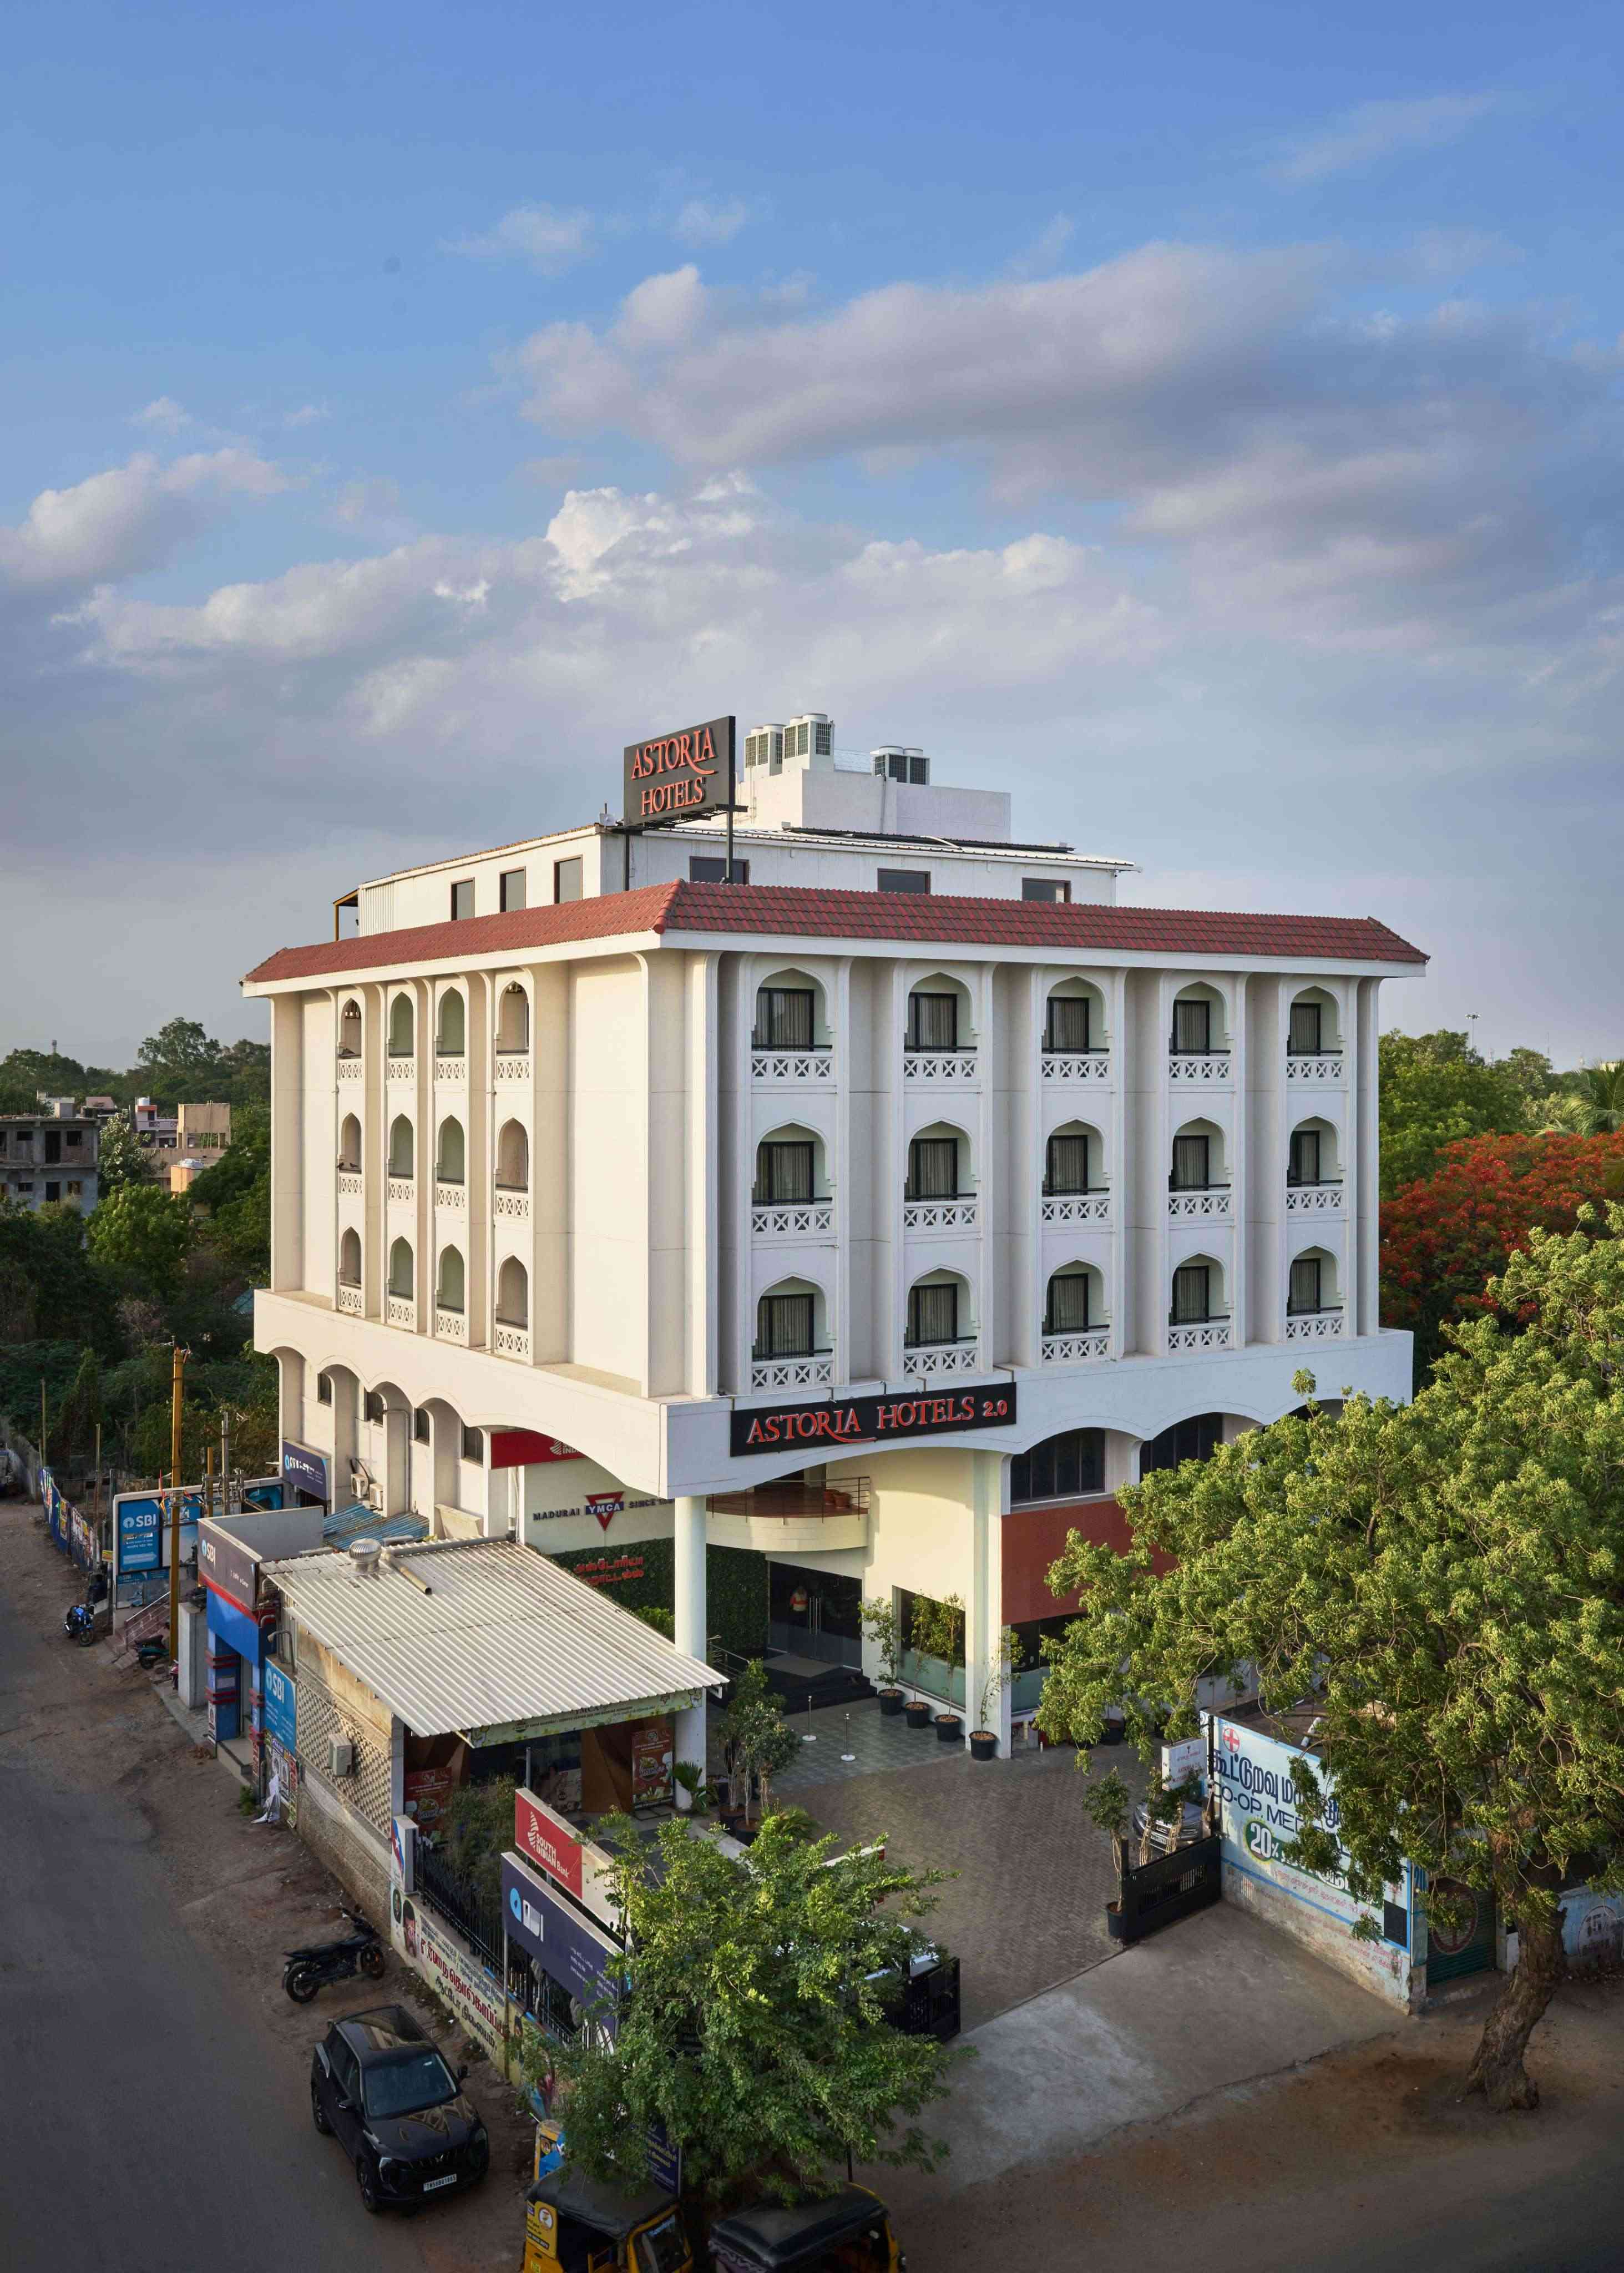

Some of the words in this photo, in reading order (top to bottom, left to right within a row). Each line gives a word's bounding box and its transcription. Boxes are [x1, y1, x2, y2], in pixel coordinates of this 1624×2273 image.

[631, 728, 717, 780] ASTORIA
[640, 776, 705, 816] HOTELS
[746, 1407, 877, 1444] ASTORIA
[877, 1396, 975, 1430] HOTELS
[983, 1399, 1008, 1417] 2.0
[136, 1514, 156, 1528] SBI
[533, 1508, 580, 1521] MADURAI
[588, 1503, 621, 1514] YMCA
[629, 1498, 656, 1509] SINCE
[206, 1543, 216, 1564] SBI
[272, 1674, 285, 1704] SBI
[536, 1833, 556, 1857] SOUTH
[536, 1843, 556, 1868] INDIAN
[556, 1861, 569, 1878] Bank
